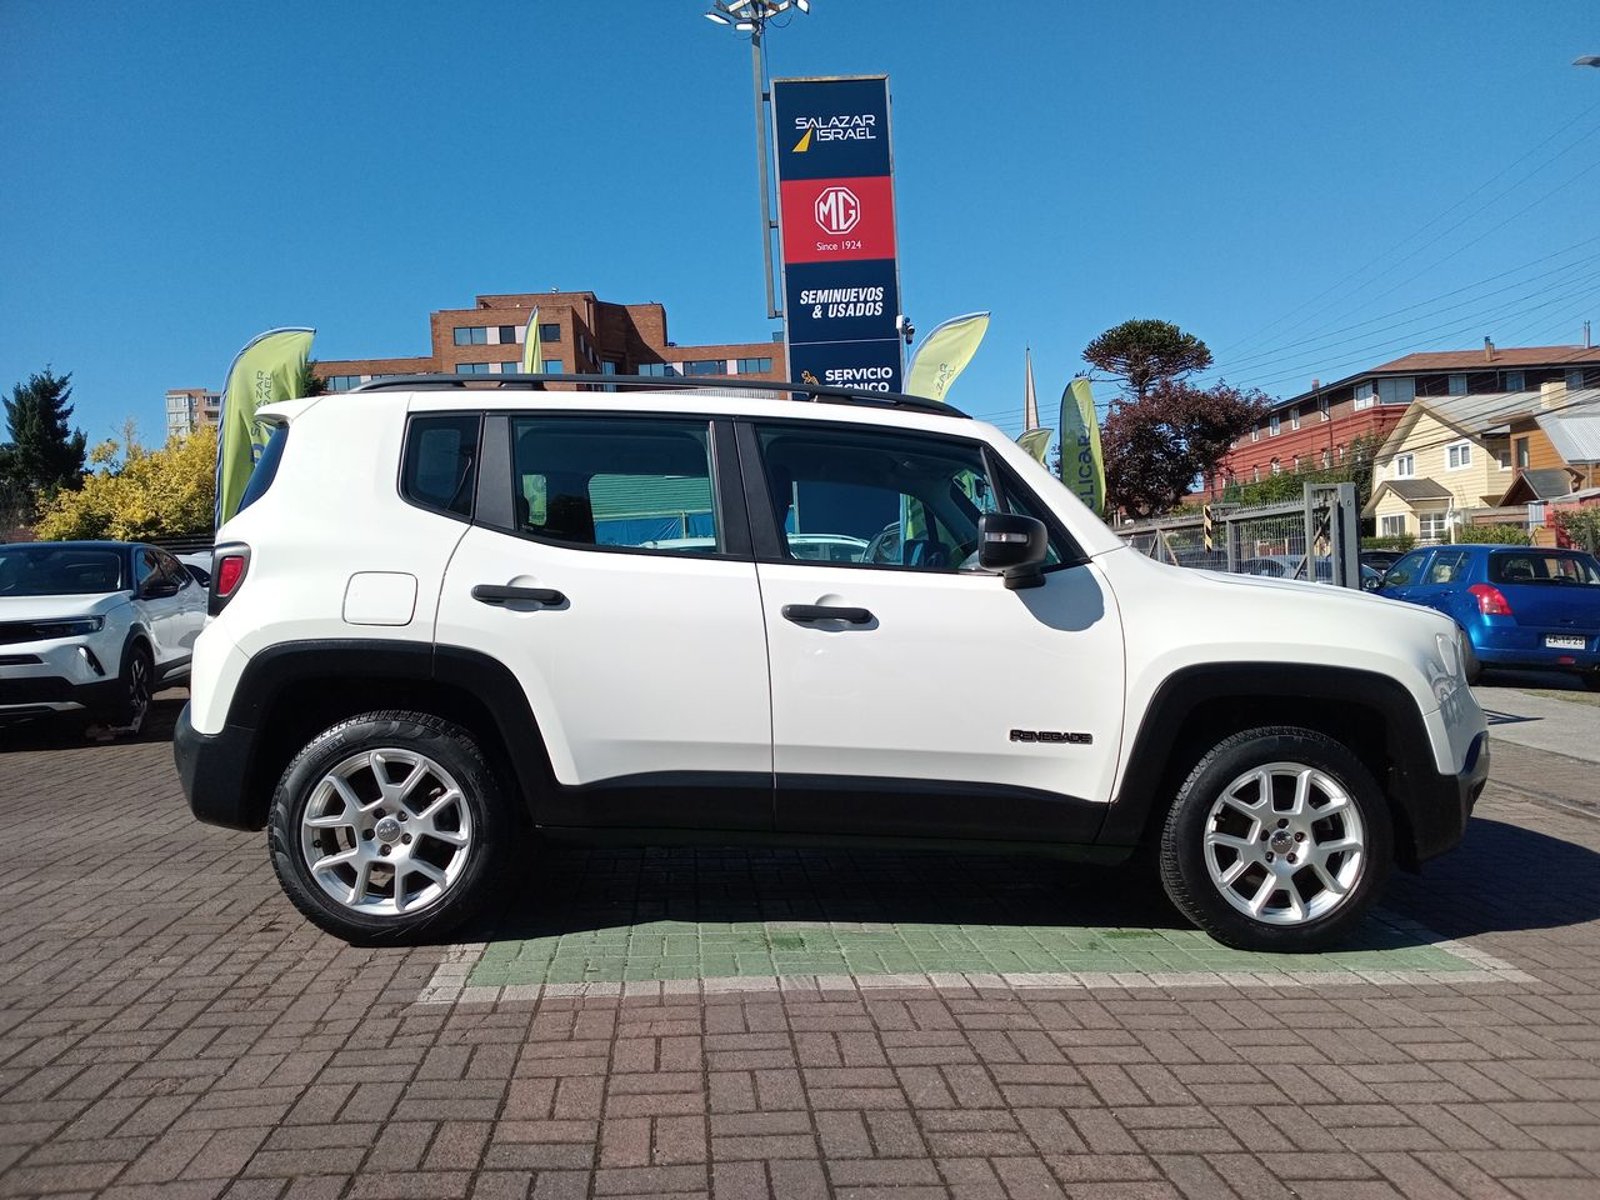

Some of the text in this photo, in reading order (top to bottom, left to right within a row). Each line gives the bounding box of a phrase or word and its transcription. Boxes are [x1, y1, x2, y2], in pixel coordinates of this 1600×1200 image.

[795, 114, 876, 129] SALAZAR
[816, 127, 876, 141] ISRAEL
[818, 191, 856, 231] MG
[816, 240, 862, 251] Since 1924
[800, 286, 884, 305] SEMINUEVOS
[812, 301, 883, 319] & USADOS
[825, 366, 893, 381] SERVICIO
[826, 380, 890, 392] NICO
[1010, 730, 1093, 744] RENEGADE
